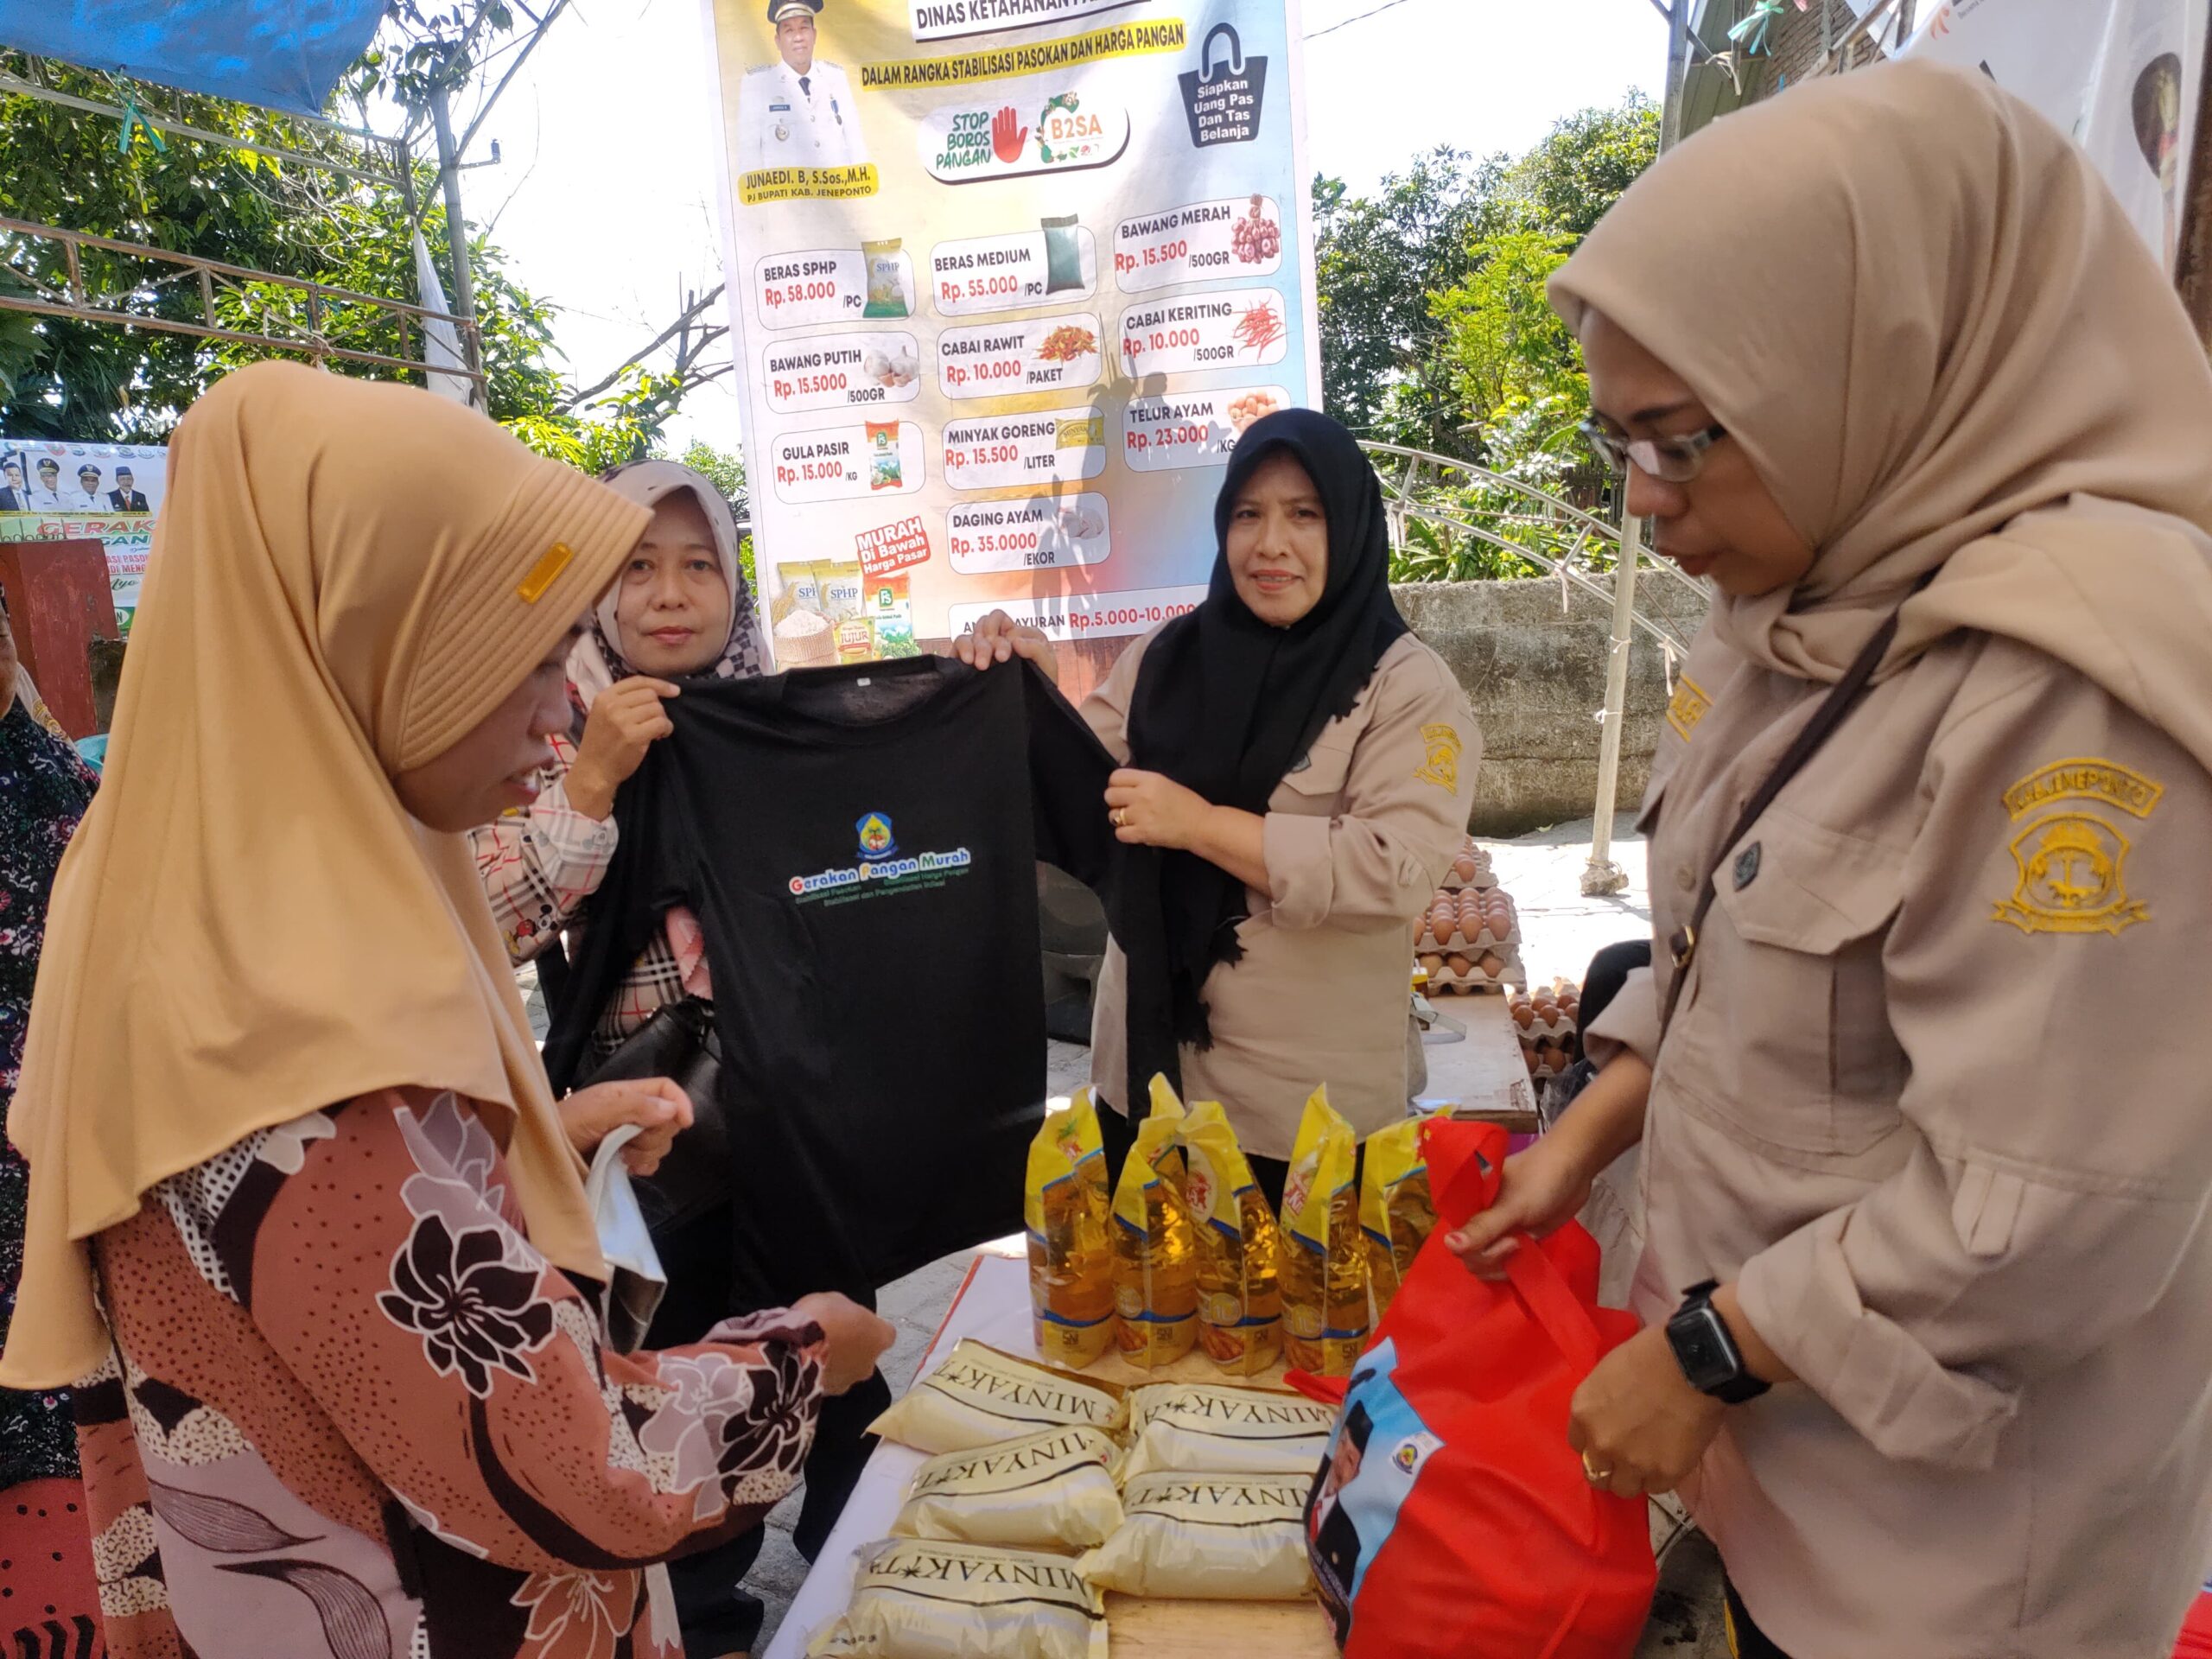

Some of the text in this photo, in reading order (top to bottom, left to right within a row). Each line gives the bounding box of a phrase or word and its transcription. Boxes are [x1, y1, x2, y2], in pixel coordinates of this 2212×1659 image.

[917, 2, 965, 29] DINAS
[861, 23, 1184, 86] DALAM RANGKA STABILISASI PASOKAN DAN HARGA PANGAN
[1198, 79, 1248, 99] Siapkan
[1194, 94, 1254, 114] Uang Pas
[952, 111, 989, 131] STOP
[1051, 114, 1103, 139] B2SA
[1198, 110, 1250, 128] Dan Tas
[947, 130, 990, 151] BOROS
[1200, 124, 1249, 142] Belanja
[936, 149, 991, 170] PANGAN
[747, 170, 794, 189] JUNAEDI.
[798, 170, 809, 186] B,
[747, 194, 756, 203] PJ
[758, 189, 788, 200] BUPATI
[816, 186, 872, 197] JENEPONTO
[1122, 206, 1230, 239] BAWANG MERAH
[934, 248, 1031, 272] BERAS MEDIUM
[1115, 239, 1230, 274] Rp. 15.500 /500GR
[764, 261, 837, 282] BERAS SPHP
[765, 281, 861, 308] Rp. 58.000 /PC
[941, 275, 1043, 303] Rp. 55.000 /PC
[1126, 302, 1232, 330] CABAI KERITING
[941, 335, 1025, 356] CABAI RAWIT
[1123, 328, 1234, 361] Rp. 10.000 /500GR
[770, 349, 861, 372] BAWANG PUTIH
[946, 359, 1063, 386] Rp. 10.000 /PAKET
[774, 372, 885, 403] Rp. 15.5000 /500GR
[1130, 402, 1214, 423] TELUR AYAM
[948, 422, 1055, 443] MINYAK GORENG
[1127, 424, 1236, 454] Rp. 23.000 /KG
[782, 442, 849, 461] GULA PASIR
[945, 445, 1055, 470] Rp. 15.500 /LITER
[777, 461, 857, 486] Rp. 15.000 /KG
[953, 509, 1043, 528] DAGING AYAM
[101, 536, 149, 545] GAN
[856, 518, 922, 550] MURAH
[861, 535, 925, 563] Di Bawah
[951, 532, 1055, 566] Rp. 35.0000 /EKOR
[864, 549, 927, 575] Harga Pasar
[830, 588, 858, 599] SPHP
[1015, 614, 1065, 627] AYURAN
[791, 868, 858, 893] Gerakan
[861, 860, 917, 879] Pangan
[922, 850, 969, 868] Murah
[931, 1363, 1096, 1422] MINYAKIT
